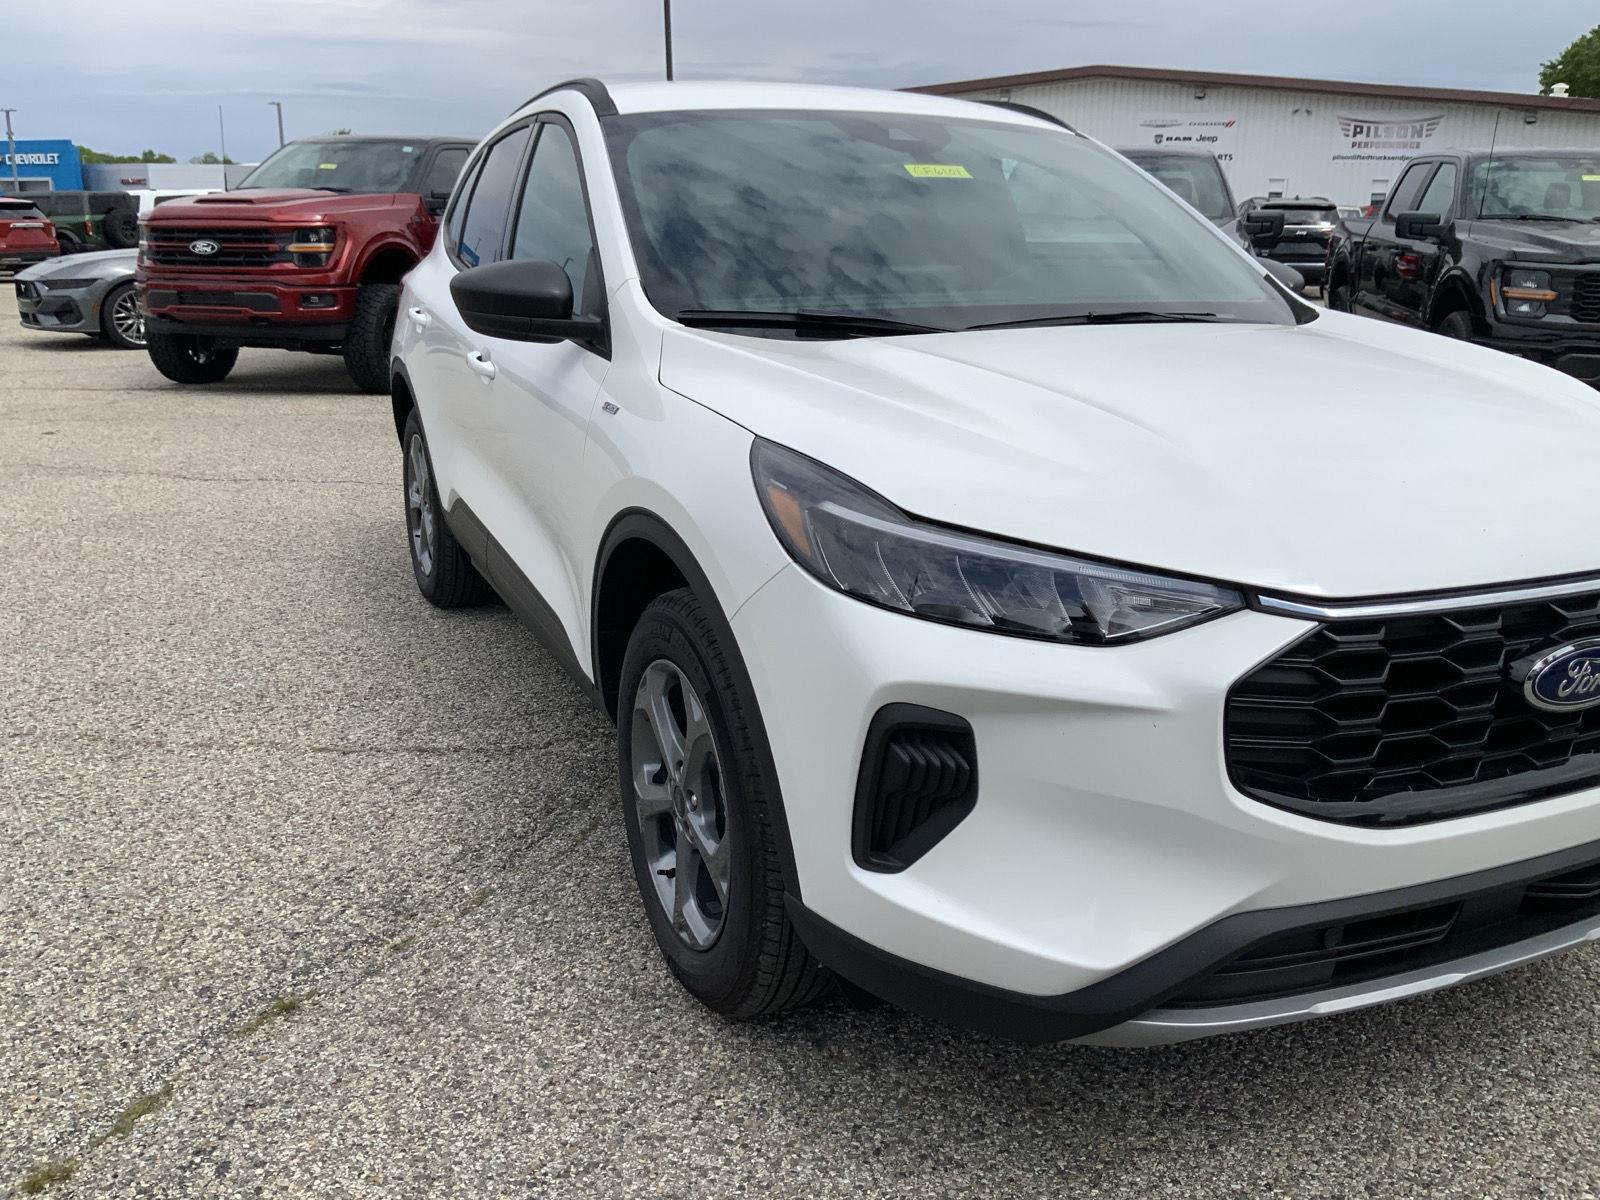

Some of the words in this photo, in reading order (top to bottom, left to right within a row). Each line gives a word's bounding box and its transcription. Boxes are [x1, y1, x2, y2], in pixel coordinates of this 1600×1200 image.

[1352, 124, 1424, 138] PILSON
[1195, 134, 1218, 143] Jeep
[1351, 141, 1421, 149] PERFORMANCE
[5, 153, 60, 165] CHEVROLET
[1217, 153, 1233, 161] RTS
[1558, 657, 1600, 697] For
